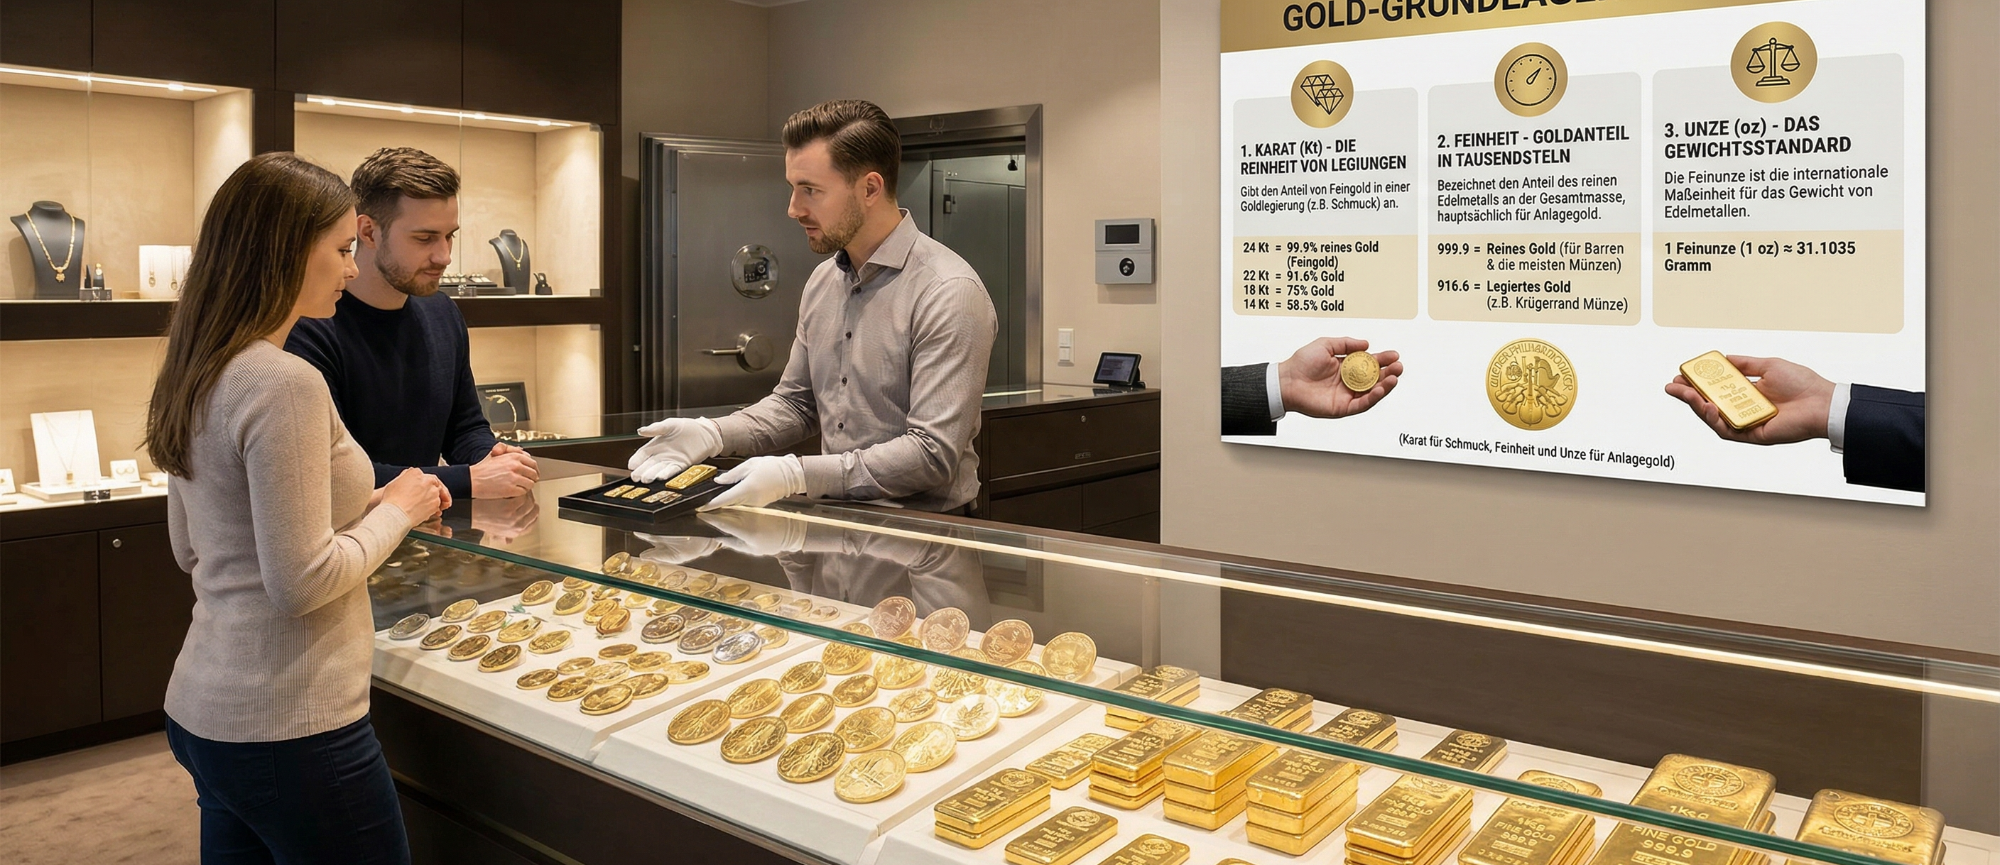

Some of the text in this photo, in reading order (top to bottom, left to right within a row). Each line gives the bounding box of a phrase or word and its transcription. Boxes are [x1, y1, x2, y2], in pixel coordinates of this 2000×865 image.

[1664, 123, 1679, 138] 3.
[1685, 120, 1729, 137] UNZE
[1735, 117, 1766, 138] (oz)
[1784, 115, 1820, 132] DAS
[1438, 135, 1450, 148] 2.
[1455, 131, 1519, 147] FEINHEIT
[1533, 125, 1629, 144] GOLDANTEIL
[1241, 145, 1251, 157] 1.
[1256, 142, 1296, 157] KARAT
[1300, 140, 1322, 158] (Kt)
[1335, 139, 1356, 153] DIE
[1665, 136, 1851, 159] GEWICHTSSTANDARD
[1241, 155, 1406, 175] REINHEIT VON LEGIUNGEN
[1438, 149, 1570, 167] IN TAUSENDSTELN
[1438, 174, 1617, 191] Bezeichnet den Anteil des reinen
[1665, 164, 1888, 184] Die Feinunze ist die internationale
[1241, 181, 1410, 197] Gibt den Anteil von Feingold in einer
[1665, 184, 1872, 201] Maßeinheit für das Gewicht von
[1241, 197, 1398, 214] Goldlegierung (z.B. Schmuck) an.
[1438, 192, 1625, 206] Edelmetalls an der Gesamtmasse,
[1438, 207, 1601, 225] hauptsächlich für Anlagegold.
[1665, 204, 1750, 218] Edelmetallen.
[1243, 242, 1256, 253] 24
[1259, 242, 1269, 253] Kt
[1287, 242, 1318, 253] 99.9%
[1321, 241, 1352, 253] reines
[1355, 241, 1378, 252] Gold
[1438, 243, 1469, 255] 999.9
[1487, 242, 1525, 255] Reines
[1529, 242, 1555, 254] Gold
[1560, 241, 1581, 257] (für
[1585, 242, 1624, 254] Barren
[1665, 242, 1670, 254] 1
[1677, 242, 1736, 255] Feinunze
[1741, 241, 1752, 257] (1
[1758, 241, 1779, 257] oz)
[1797, 241, 1855, 254] 31.1035
[1287, 256, 1338, 271] (Feingold)
[1487, 257, 1621, 274] & die meisten Münzen)
[1665, 259, 1711, 271] Gramm
[1243, 270, 1256, 281] 22
[1259, 270, 1269, 281] Kt
[1287, 269, 1318, 282] 91.6%
[1321, 269, 1344, 282] Gold
[1244, 284, 1256, 295] 18
[1259, 284, 1269, 295] Kt
[1287, 285, 1308, 296] 75%
[1311, 285, 1334, 296] Gold
[1438, 280, 1469, 291] 916.6
[1487, 280, 1540, 295] Legiertes
[1544, 280, 1570, 293] Gold
[1244, 299, 1256, 309] 14
[1259, 299, 1269, 309] Kt
[1287, 299, 1318, 311] 58.5%
[1321, 300, 1344, 311] Gold
[1487, 296, 1628, 314] (z.B. Krügerrand Münze)
[1399, 433, 1674, 470] (Karat für Schmuck, Feinheit und Unze für Anlagegold)
[1630, 825, 1718, 852] FINE GOLD
[1643, 839, 1694, 859] 999.9
